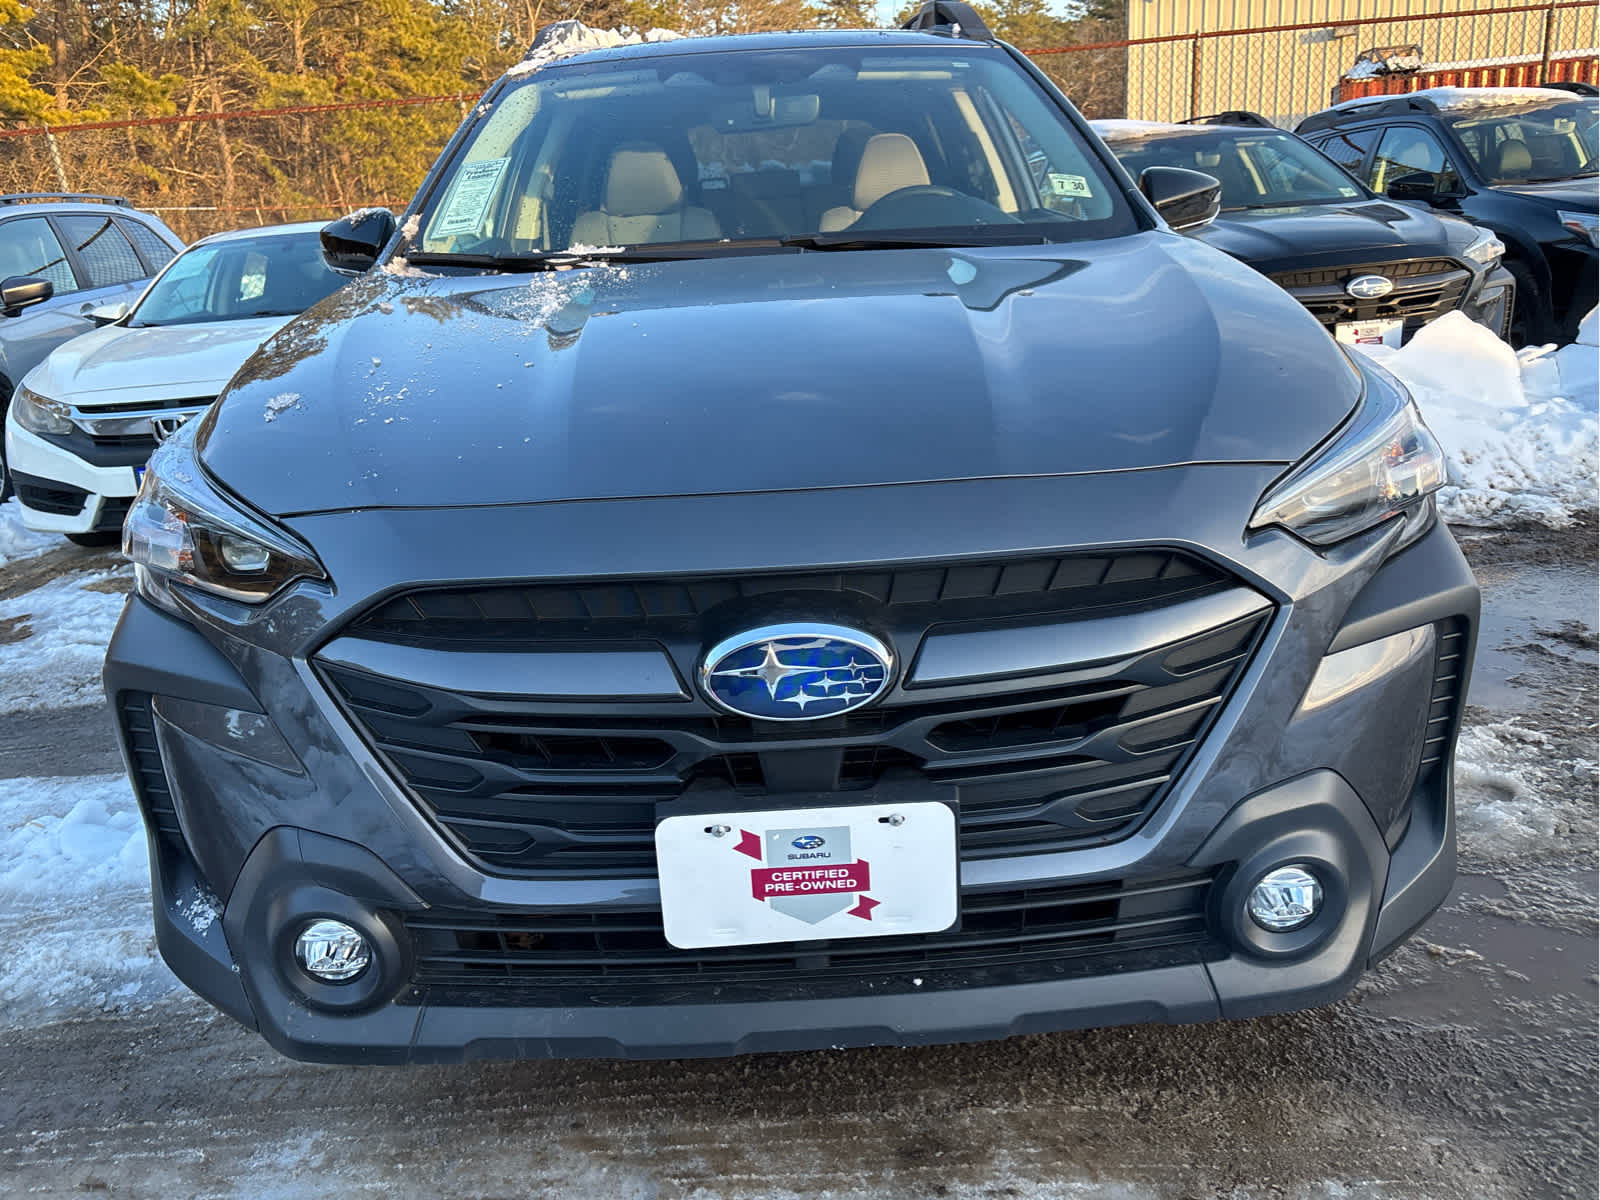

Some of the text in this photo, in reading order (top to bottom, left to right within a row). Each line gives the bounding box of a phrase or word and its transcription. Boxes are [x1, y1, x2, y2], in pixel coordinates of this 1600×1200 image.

[1057, 181, 1085, 190] 7 30
[787, 852, 831, 860] SUBARU
[771, 868, 849, 881] CERTIFIED
[765, 879, 857, 892] PRE-OWNED
